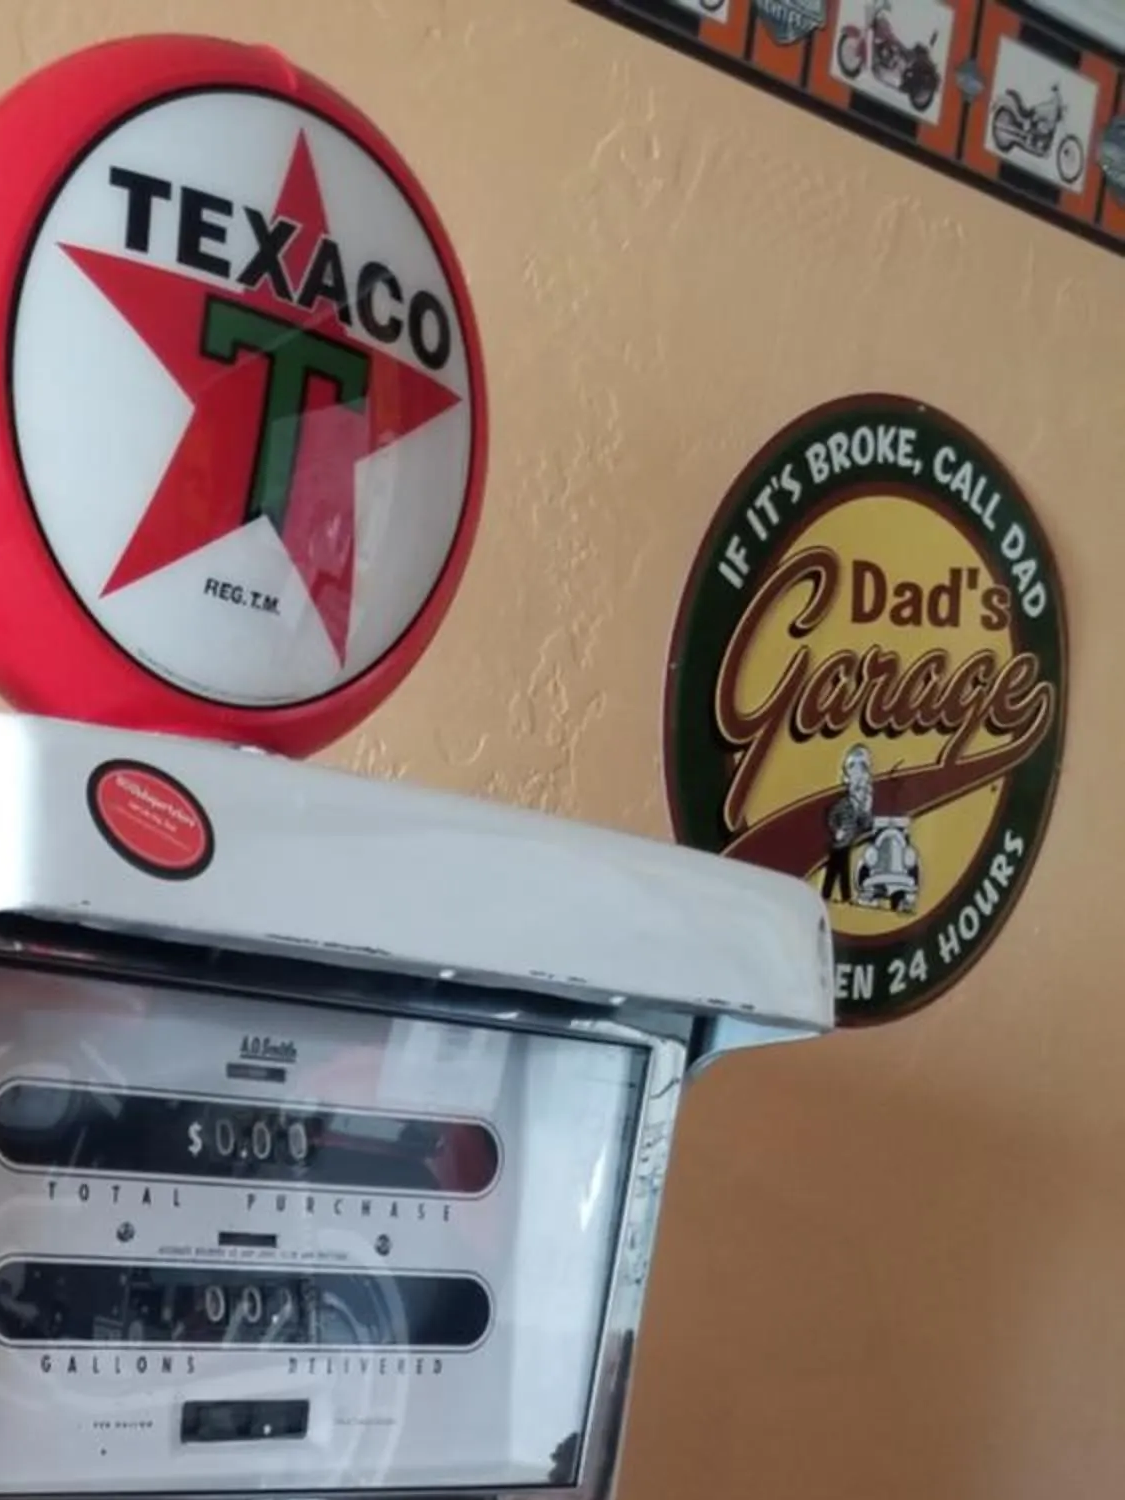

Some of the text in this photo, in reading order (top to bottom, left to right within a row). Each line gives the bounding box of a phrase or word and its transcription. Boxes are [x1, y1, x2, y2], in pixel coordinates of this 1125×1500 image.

[107, 165, 453, 371] TEXACO
[717, 424, 1048, 618] IF IT'S BROKE, CALL DAD
[851, 558, 1012, 633] Dad's
[715, 546, 1056, 832] Garage
[833, 829, 1025, 1001] EN 24 HOURS
[47, 1181, 452, 1222] TOTAL PURCHASE
[39, 1354, 444, 1376] GALLONS DELIVERED
